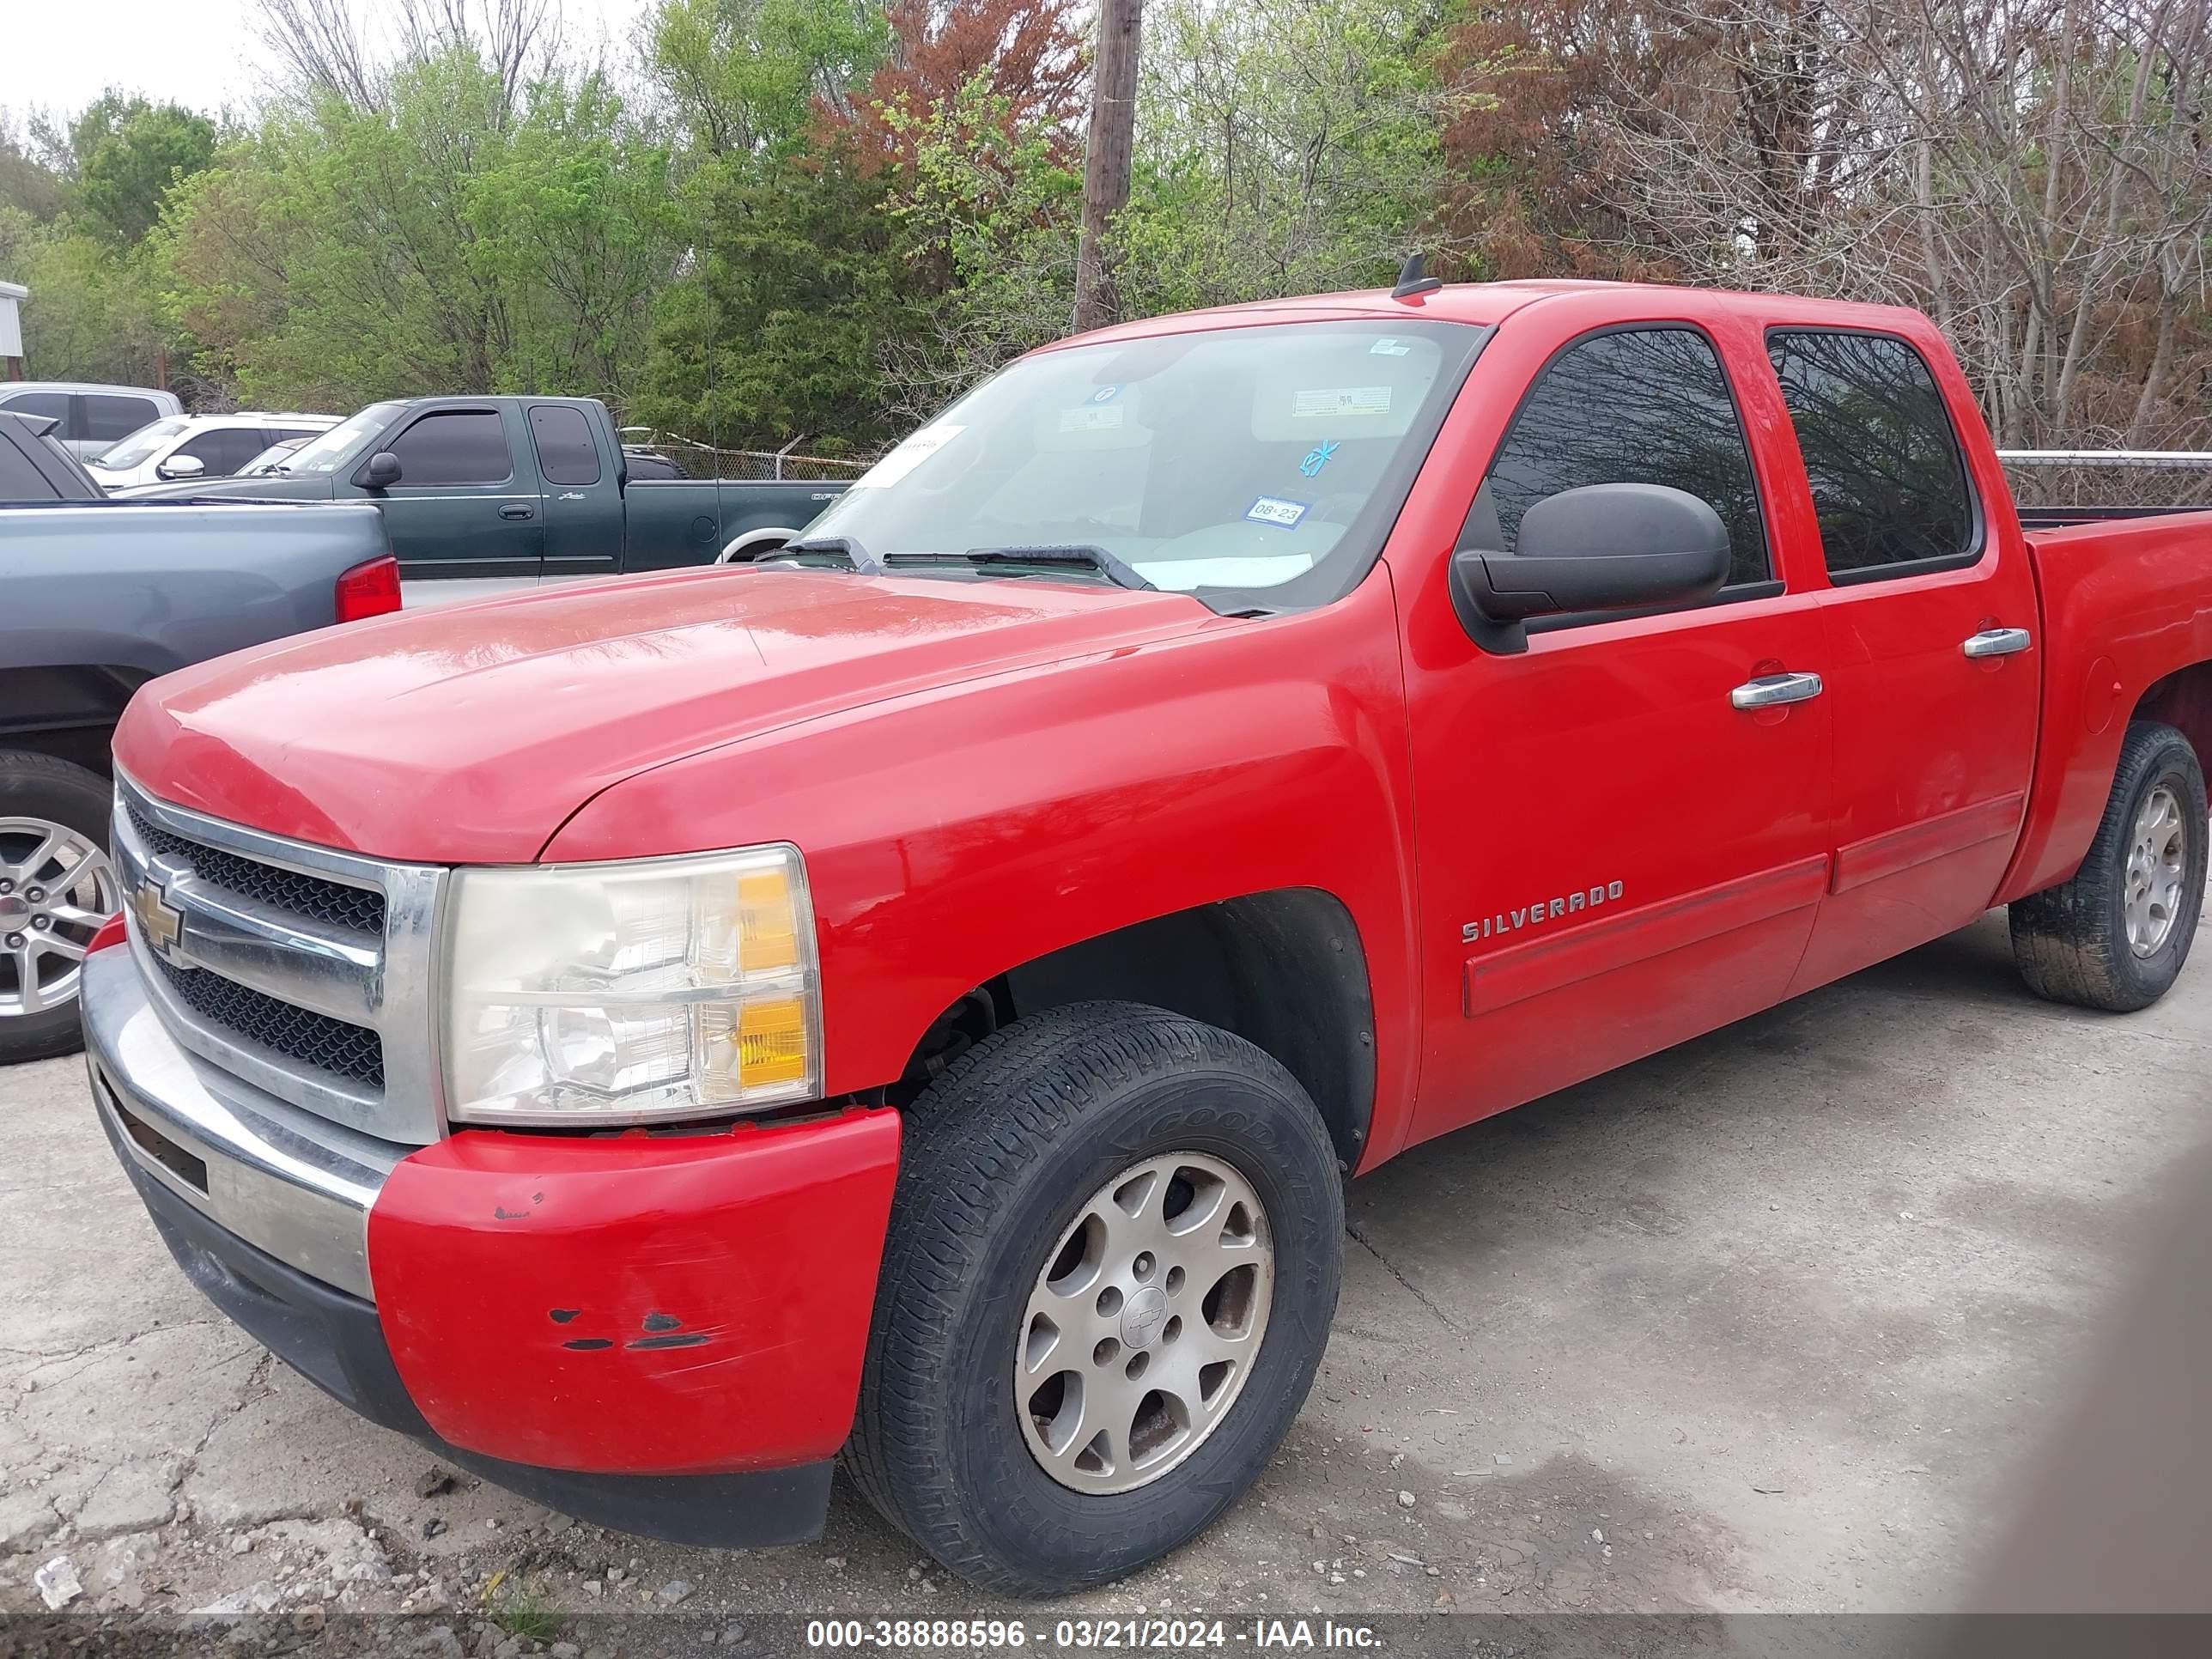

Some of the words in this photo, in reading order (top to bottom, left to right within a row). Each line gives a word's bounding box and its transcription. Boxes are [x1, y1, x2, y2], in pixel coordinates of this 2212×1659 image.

[1255, 504, 1274, 515] 08
[1277, 508, 1298, 520] 23
[1462, 879, 1624, 944] SILVERADO
